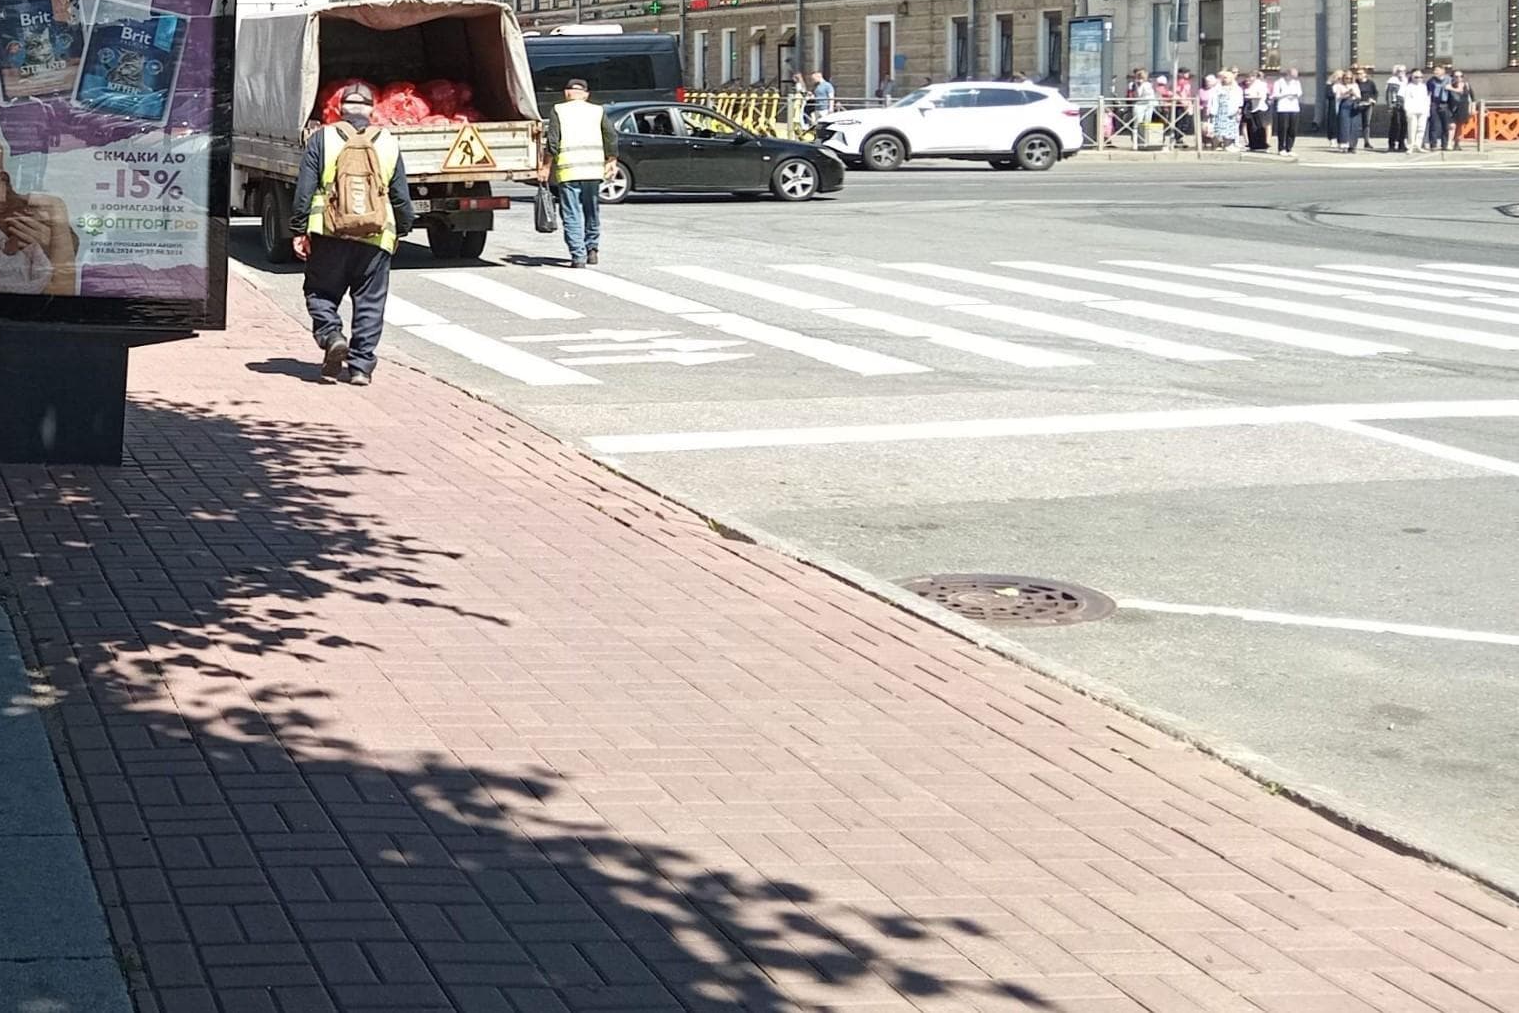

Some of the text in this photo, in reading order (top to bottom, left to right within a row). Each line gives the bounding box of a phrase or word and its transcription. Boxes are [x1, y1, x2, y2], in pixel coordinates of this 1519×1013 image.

[20, 11, 52, 27] Brit
[121, 26, 152, 45] Brit
[93, 151, 186, 165] СКИДКИ ДО
[96, 169, 184, 200] -15%
[100, 204, 184, 213] ЗООМАГАЗИНАХ
